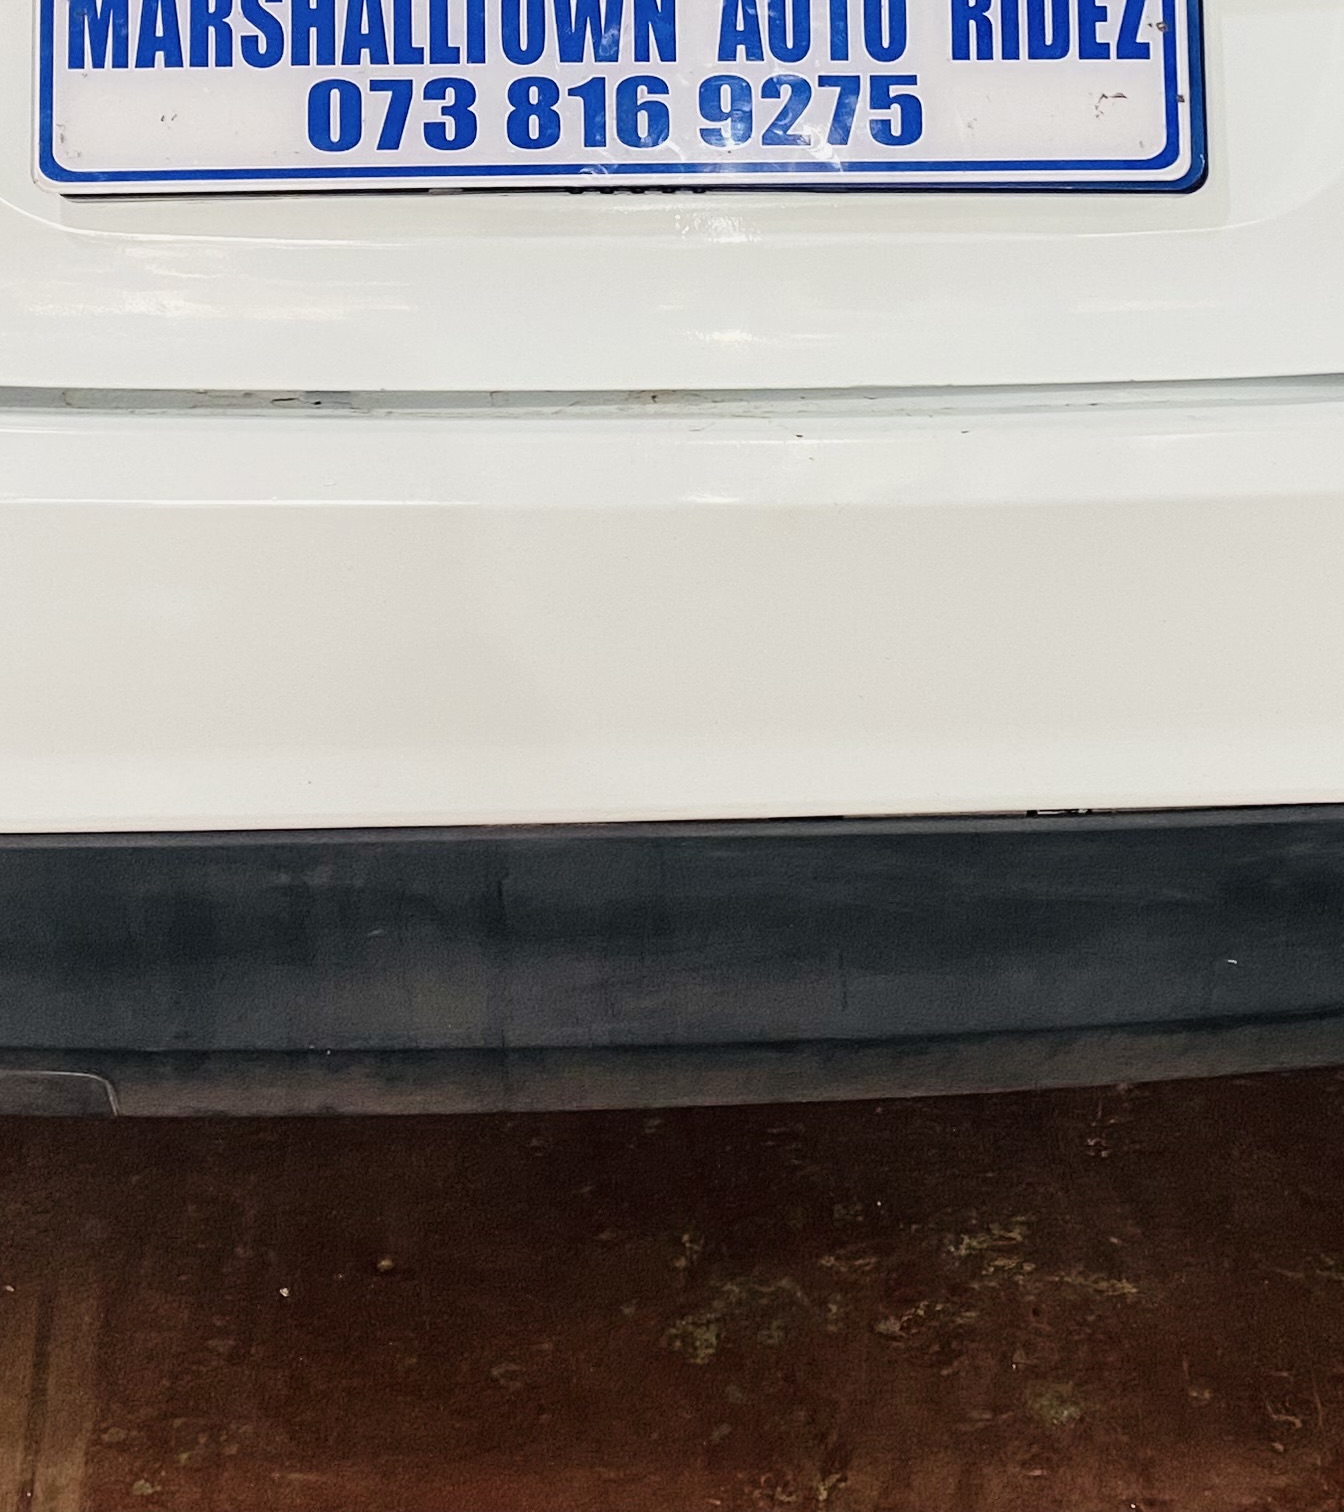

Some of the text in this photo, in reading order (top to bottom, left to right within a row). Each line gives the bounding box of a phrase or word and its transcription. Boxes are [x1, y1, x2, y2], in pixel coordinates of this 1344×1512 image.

[307, 74, 923, 151] 073 816 9275
